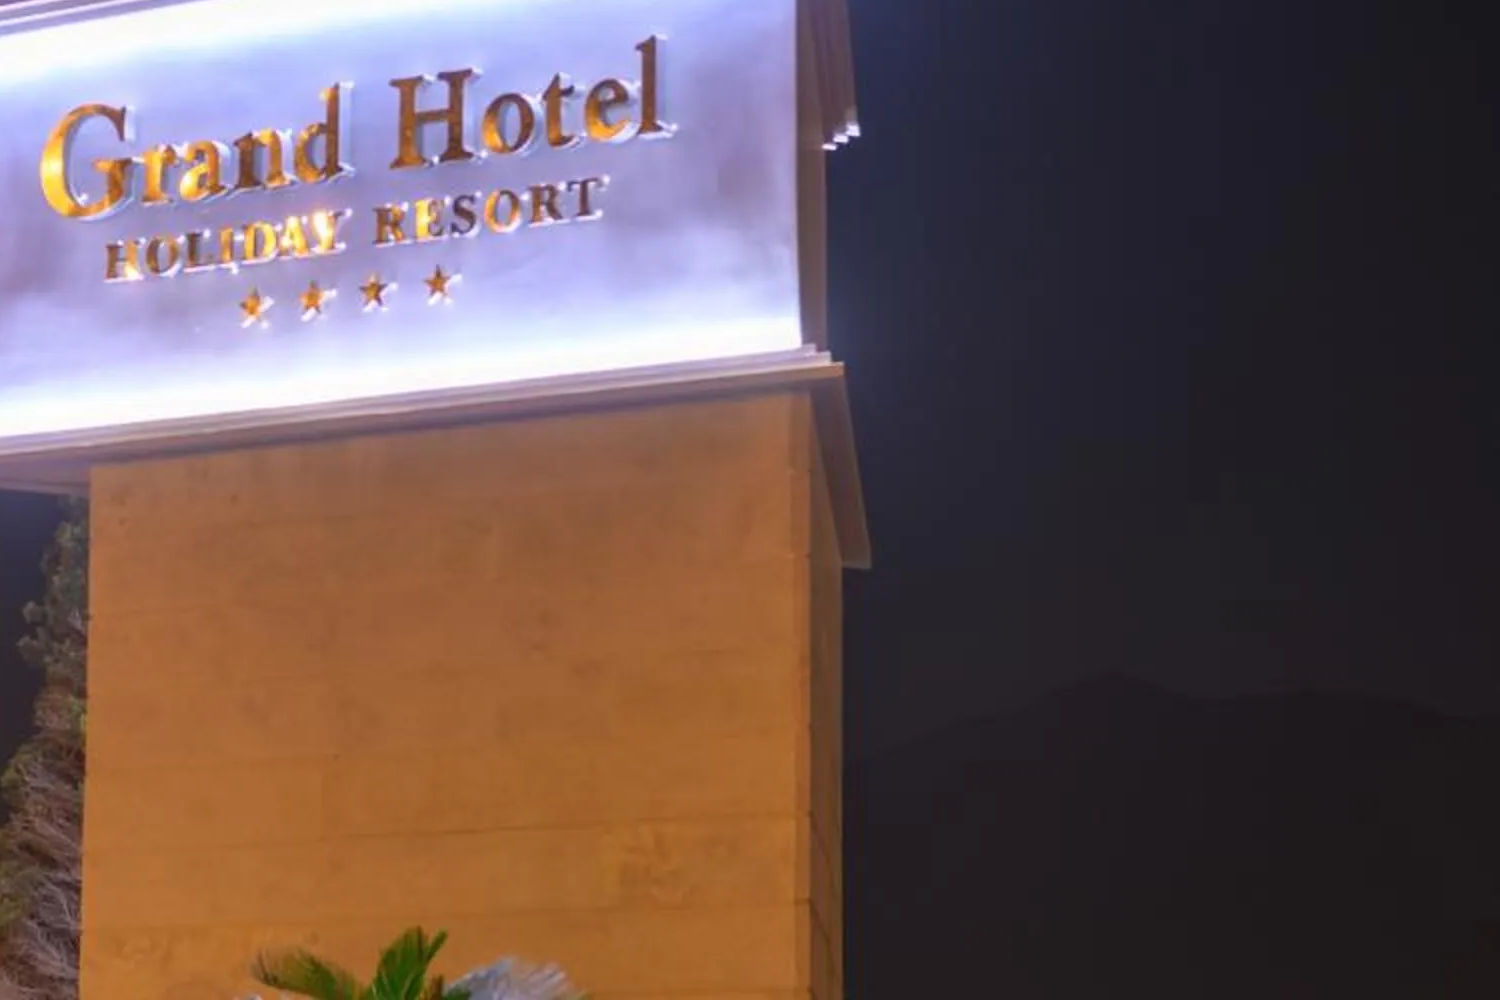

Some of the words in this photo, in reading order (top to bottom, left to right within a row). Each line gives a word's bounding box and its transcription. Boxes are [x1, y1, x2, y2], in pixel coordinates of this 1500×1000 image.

[40, 81, 350, 219] Grand
[390, 34, 676, 170] Hotel
[105, 209, 346, 280] HOLIDAY
[373, 176, 606, 246] RESORT
